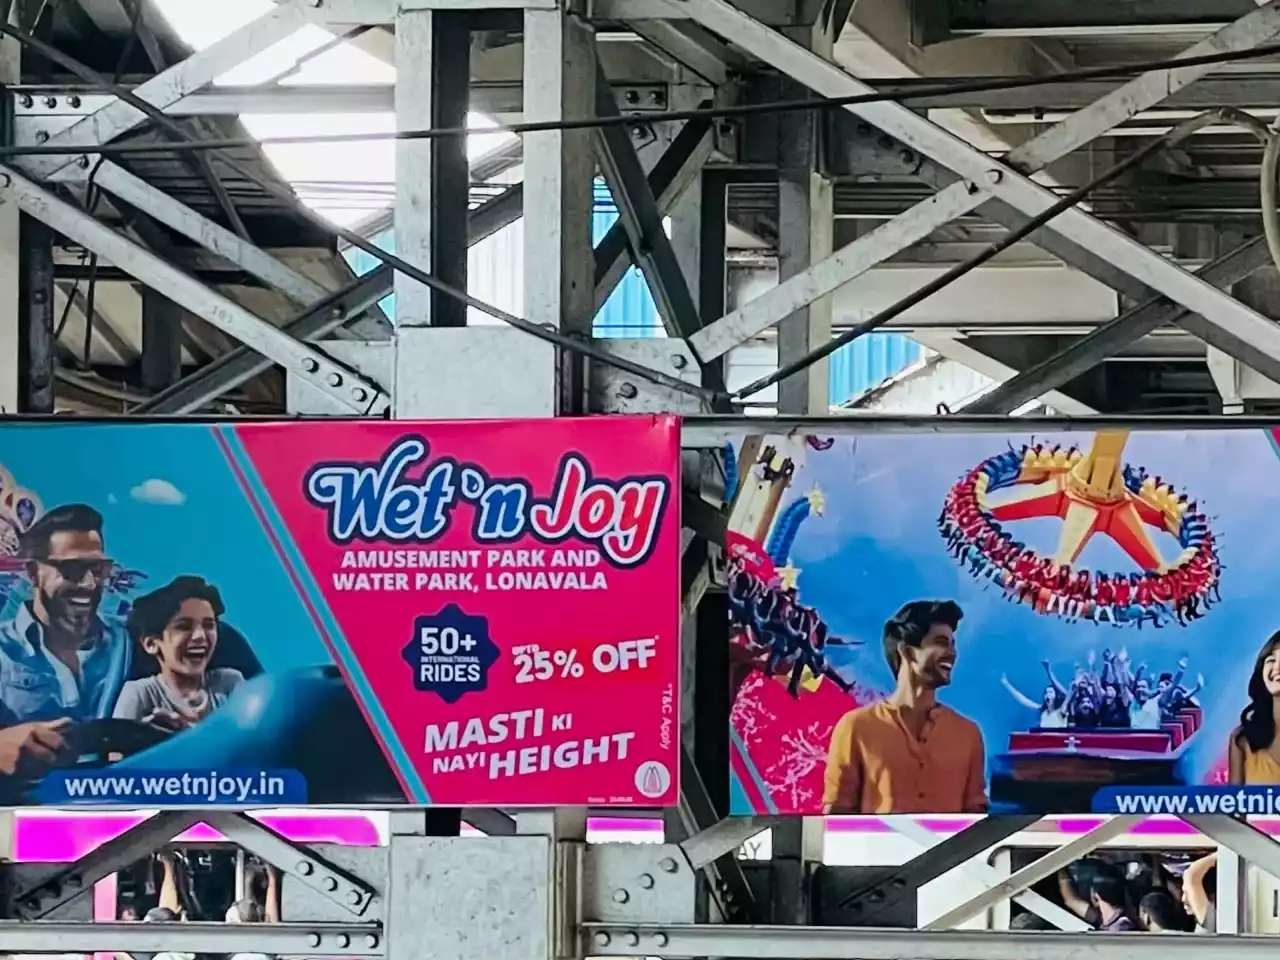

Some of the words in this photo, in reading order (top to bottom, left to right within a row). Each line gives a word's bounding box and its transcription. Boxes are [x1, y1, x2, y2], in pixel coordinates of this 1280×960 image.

[309, 440, 455, 539] Wet
[530, 457, 665, 564] Joy
[341, 550, 481, 568] AMUSEMENT
[487, 550, 548, 567] PARK
[550, 550, 600, 567] AND
[333, 573, 408, 591] WATER
[416, 572, 478, 592] PARK,
[486, 571, 607, 590] LONAVALA
[421, 627, 476, 654] 50+
[421, 664, 480, 682] RIDES
[513, 648, 584, 684] 25%
[424, 708, 544, 753] MASTI
[551, 713, 572, 732] KI
[433, 751, 486, 774] NAYI
[488, 732, 635, 779] HEIGHT
[64, 771, 284, 802] www.wetnjoy.in
